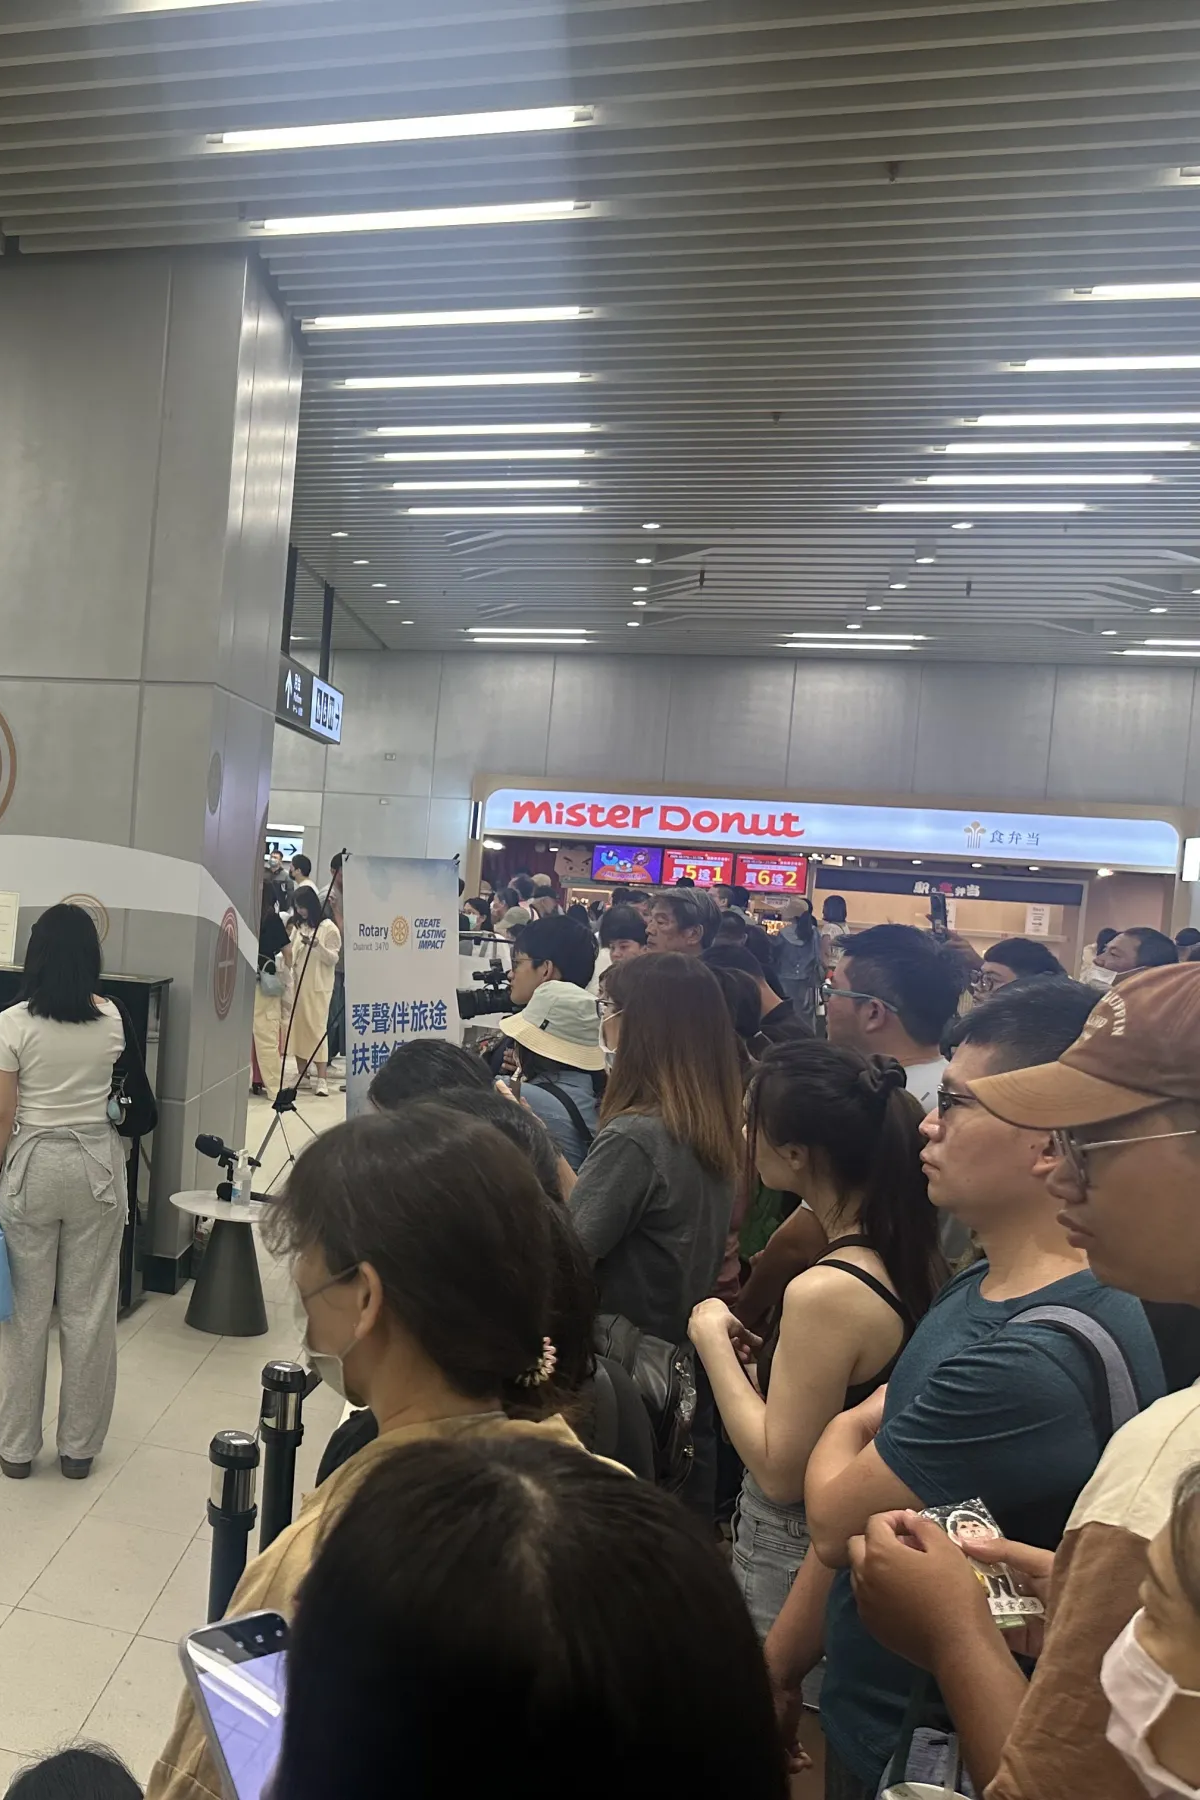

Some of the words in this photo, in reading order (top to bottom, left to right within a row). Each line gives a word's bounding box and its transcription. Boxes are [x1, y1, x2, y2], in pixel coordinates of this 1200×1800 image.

[659, 806, 805, 838] Donut
[990, 830, 1040, 846] 食弁当
[415, 919, 441, 928] CREATE
[359, 924, 389, 940] Rotary
[417, 930, 447, 939] LASTING
[353, 943, 373, 951] District
[375, 943, 389, 951] 3470
[418, 941, 445, 950] IMPACT
[352, 1000, 447, 1036] 琴聲伴旅途
[352, 1039, 413, 1076] 扶輪
